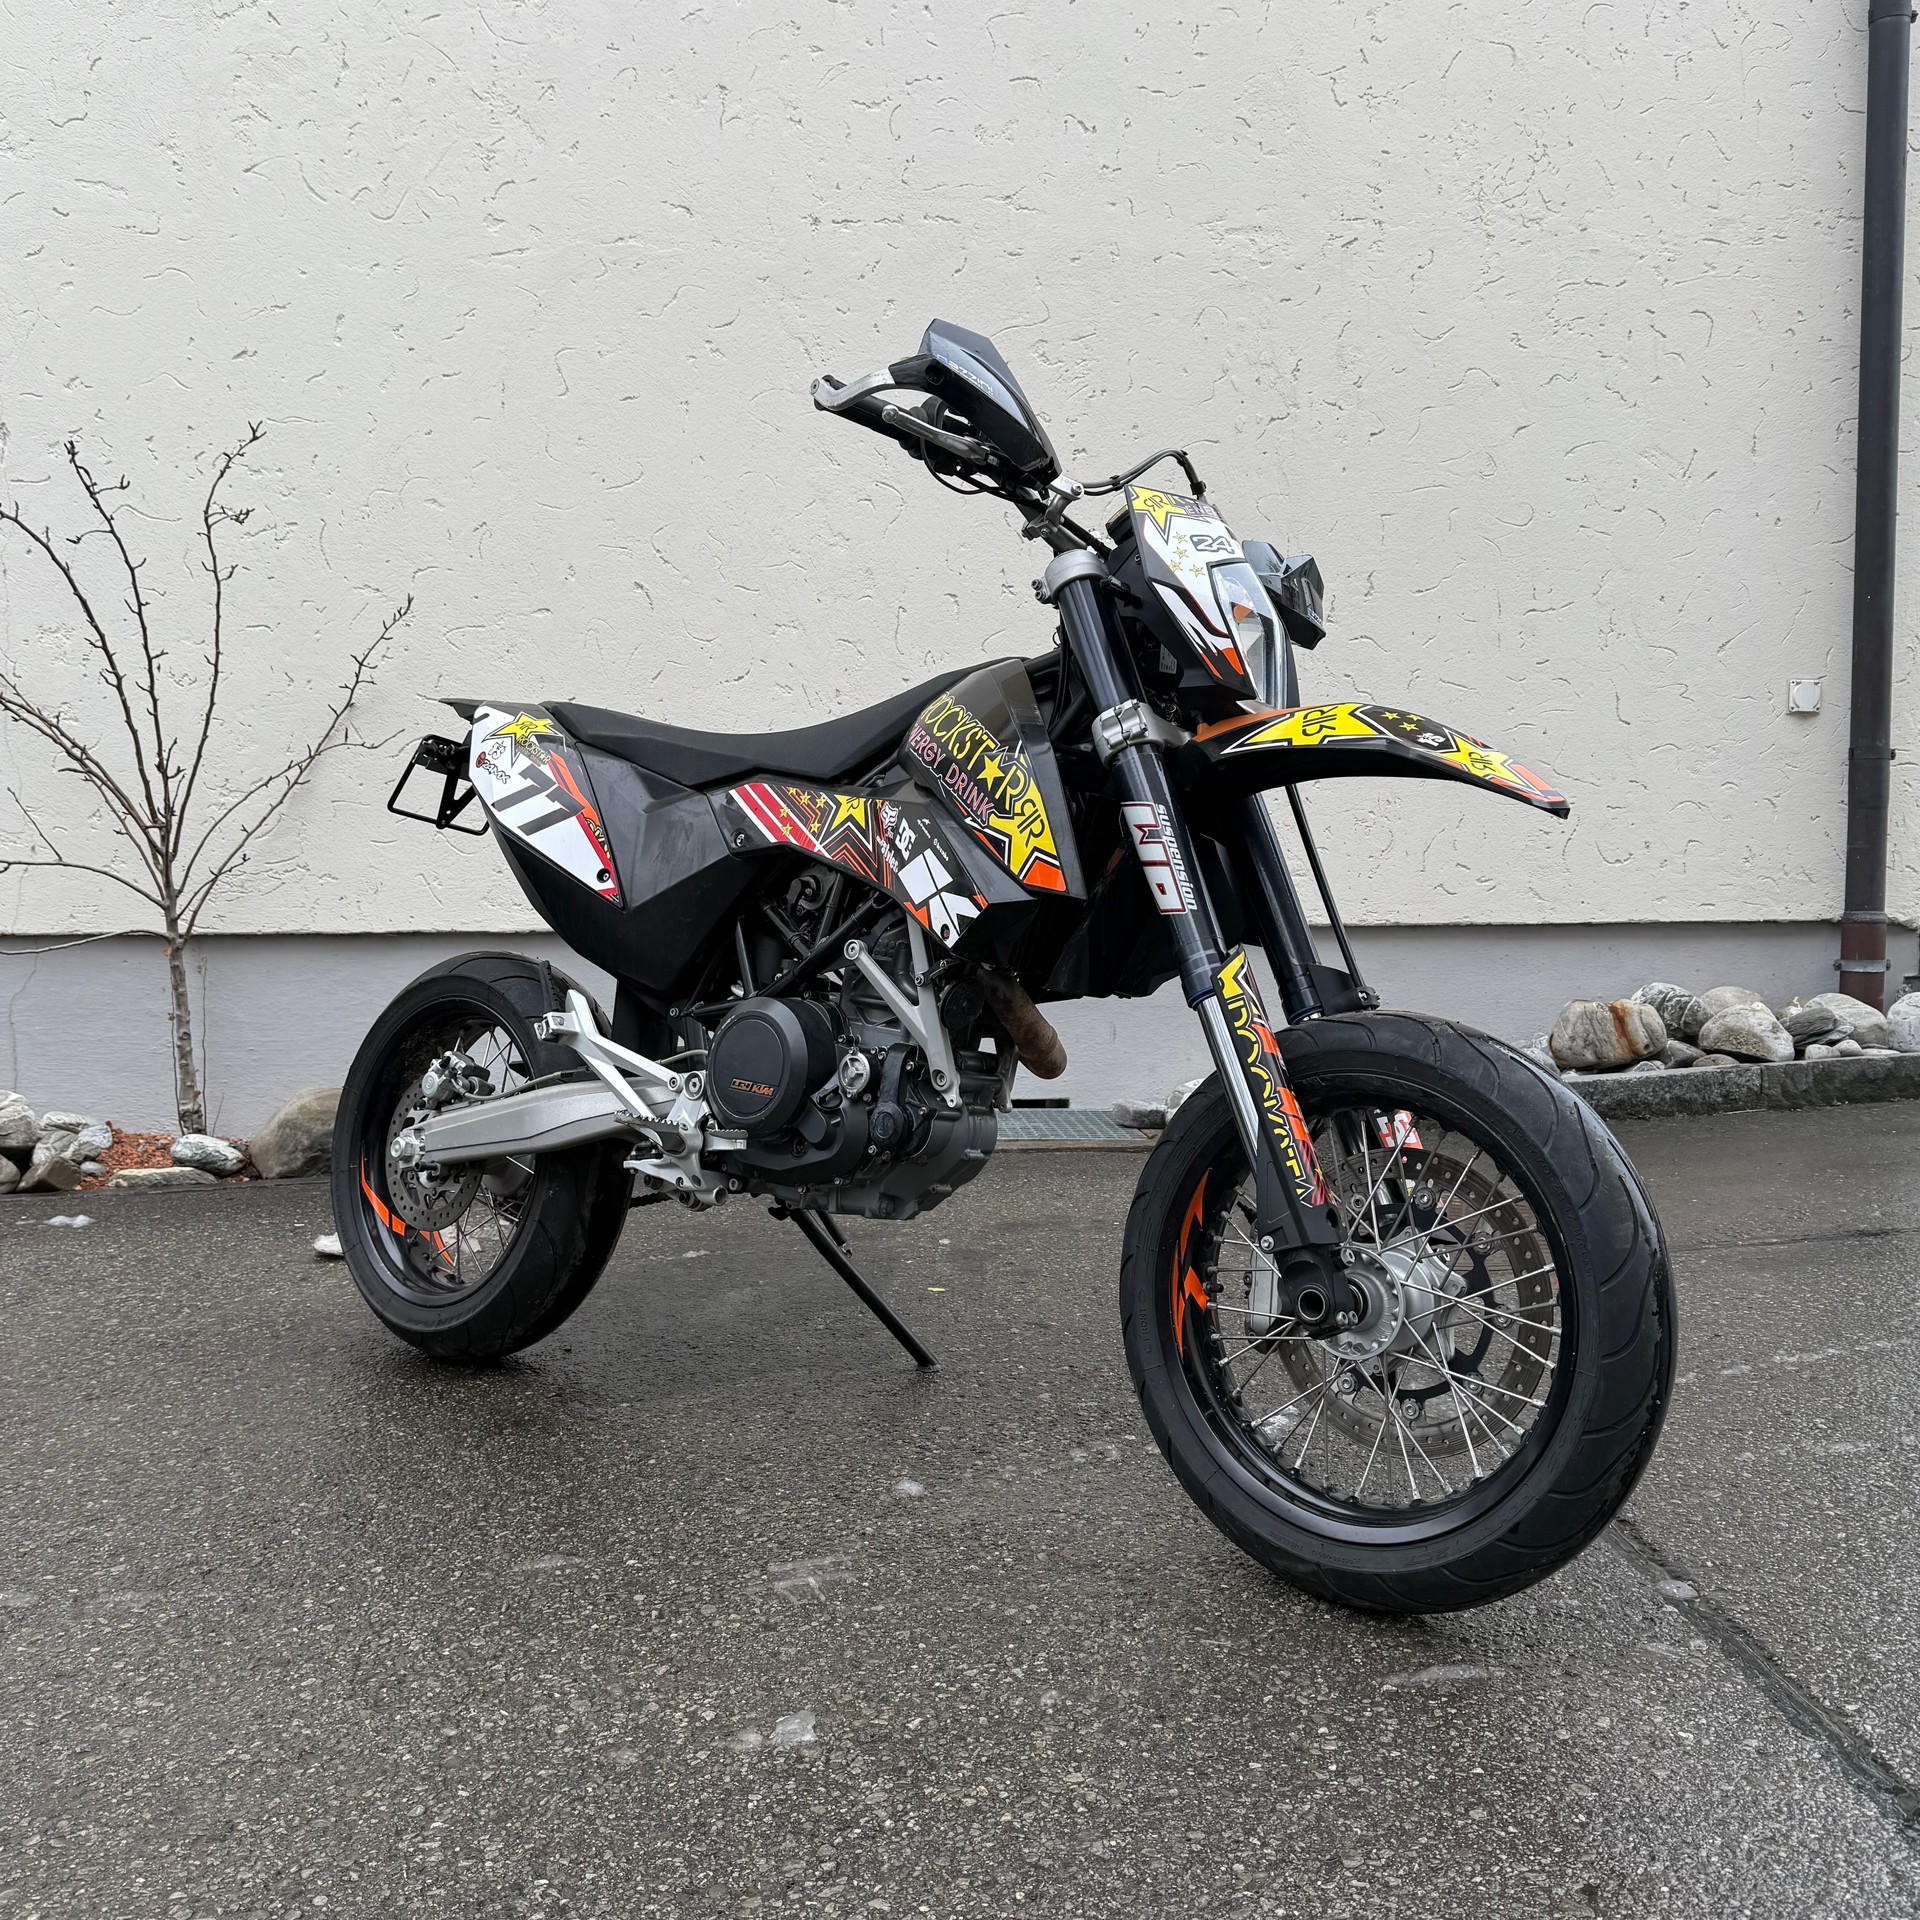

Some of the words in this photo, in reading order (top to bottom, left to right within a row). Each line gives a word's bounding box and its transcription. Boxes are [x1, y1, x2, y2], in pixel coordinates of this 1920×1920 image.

[491, 763, 586, 836] 77
[945, 763, 994, 821] DRINK
[1155, 803, 1198, 910] suspension
